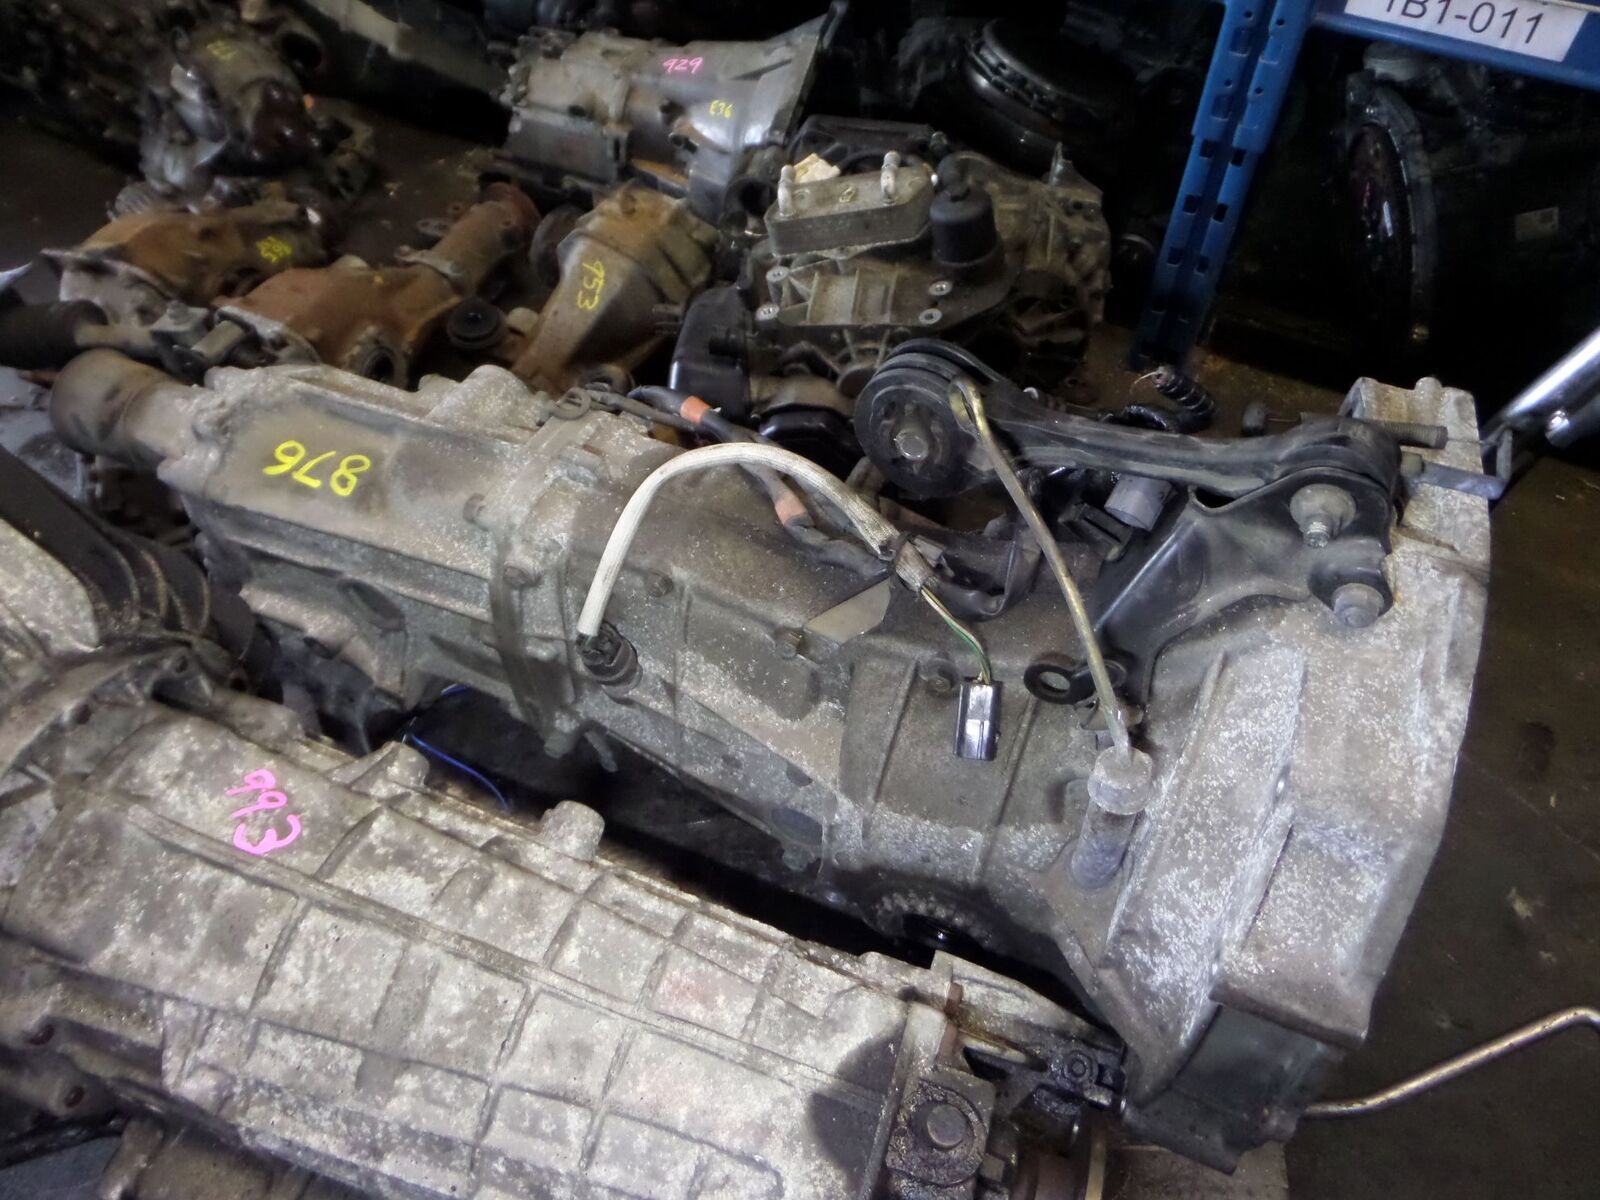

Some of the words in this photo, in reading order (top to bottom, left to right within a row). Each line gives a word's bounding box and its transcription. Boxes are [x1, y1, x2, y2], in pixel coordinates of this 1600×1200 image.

[663, 56, 704, 74] 929
[577, 259, 606, 310] 953
[263, 440, 371, 497] 876
[226, 769, 301, 854] 993
